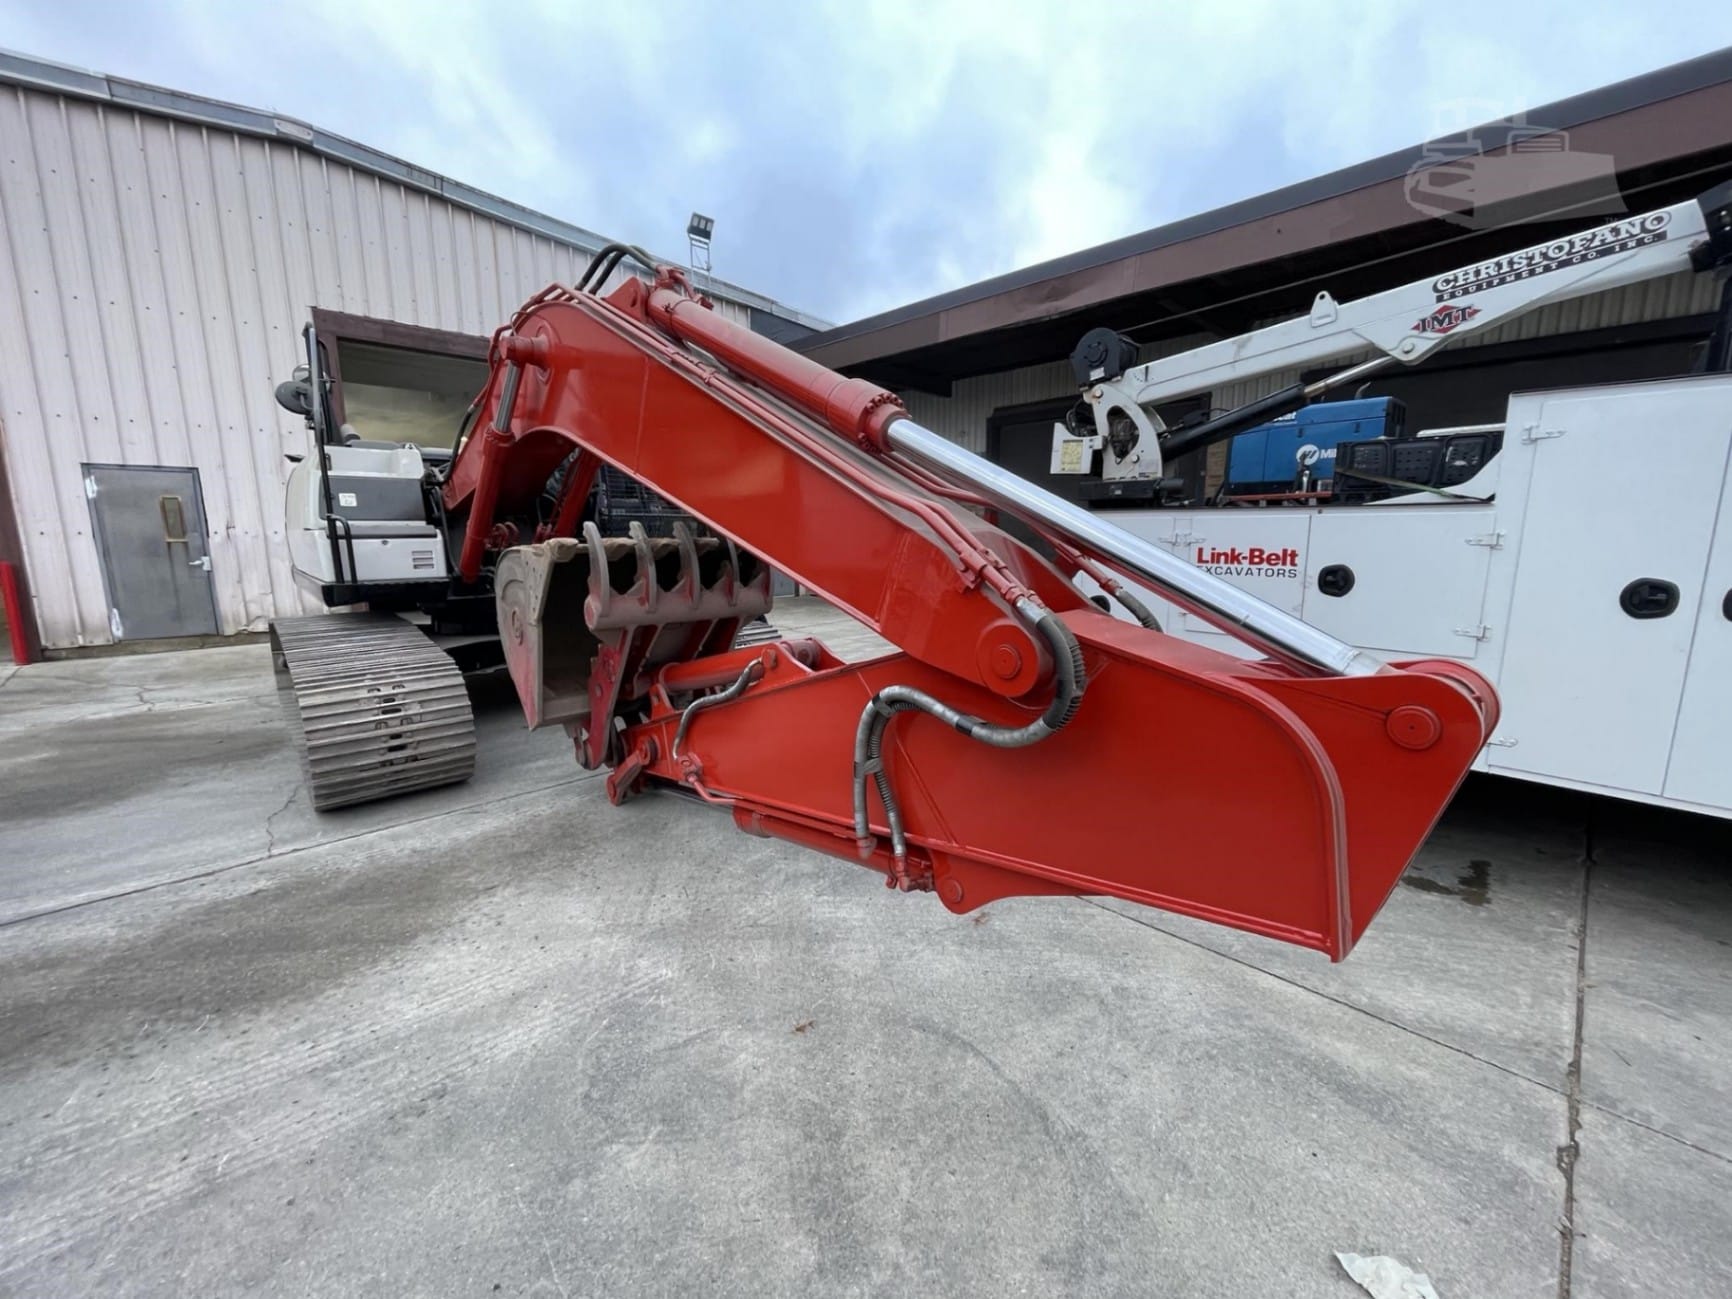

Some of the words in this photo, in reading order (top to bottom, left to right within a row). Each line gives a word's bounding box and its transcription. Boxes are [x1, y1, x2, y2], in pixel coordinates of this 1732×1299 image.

[1434, 211, 1671, 292] CHRISTOFANO
[1443, 262, 1559, 300] EQUIPMENT
[1418, 304, 1475, 333] IMT
[1197, 547, 1299, 567] Link-Belt
